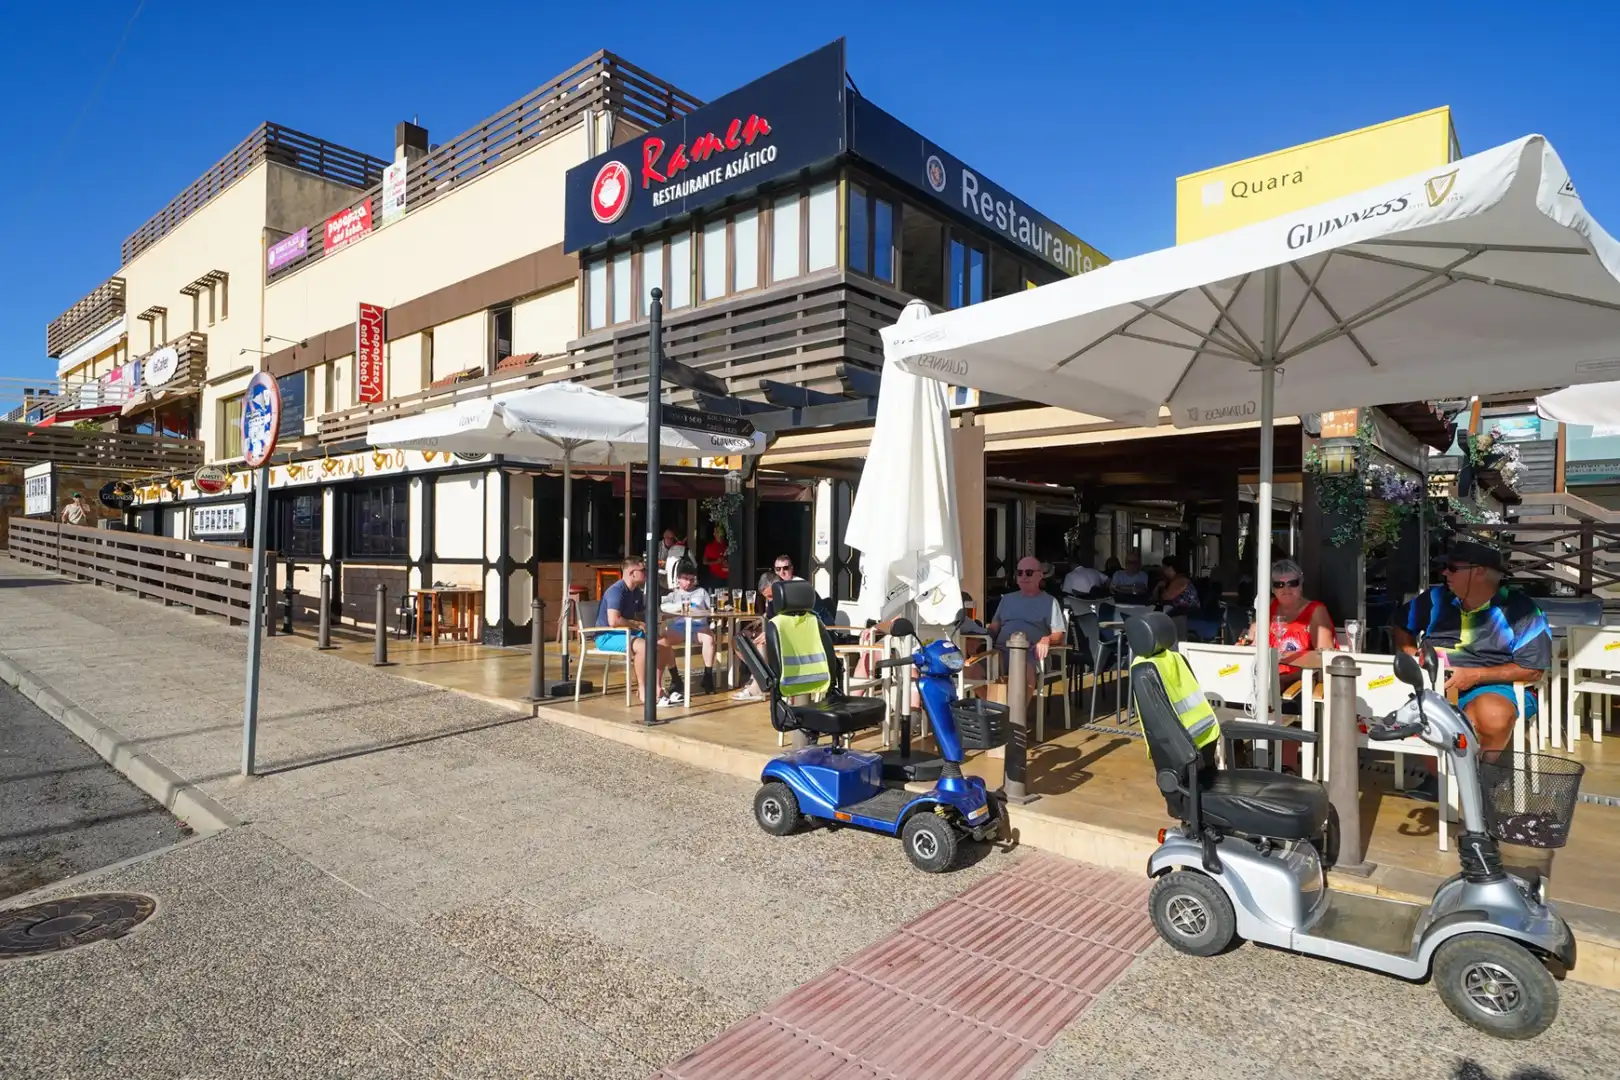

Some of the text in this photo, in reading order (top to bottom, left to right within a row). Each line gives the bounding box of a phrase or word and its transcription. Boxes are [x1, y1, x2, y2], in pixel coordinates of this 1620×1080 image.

[642, 113, 773, 189] Ramen
[652, 145, 778, 207] RESTAURANTE ASIÁTICO
[1230, 168, 1304, 199] Quara
[961, 168, 1093, 274] Restaurante
[1286, 192, 1412, 251] GUINNESS
[360, 324, 370, 382] and kebab
